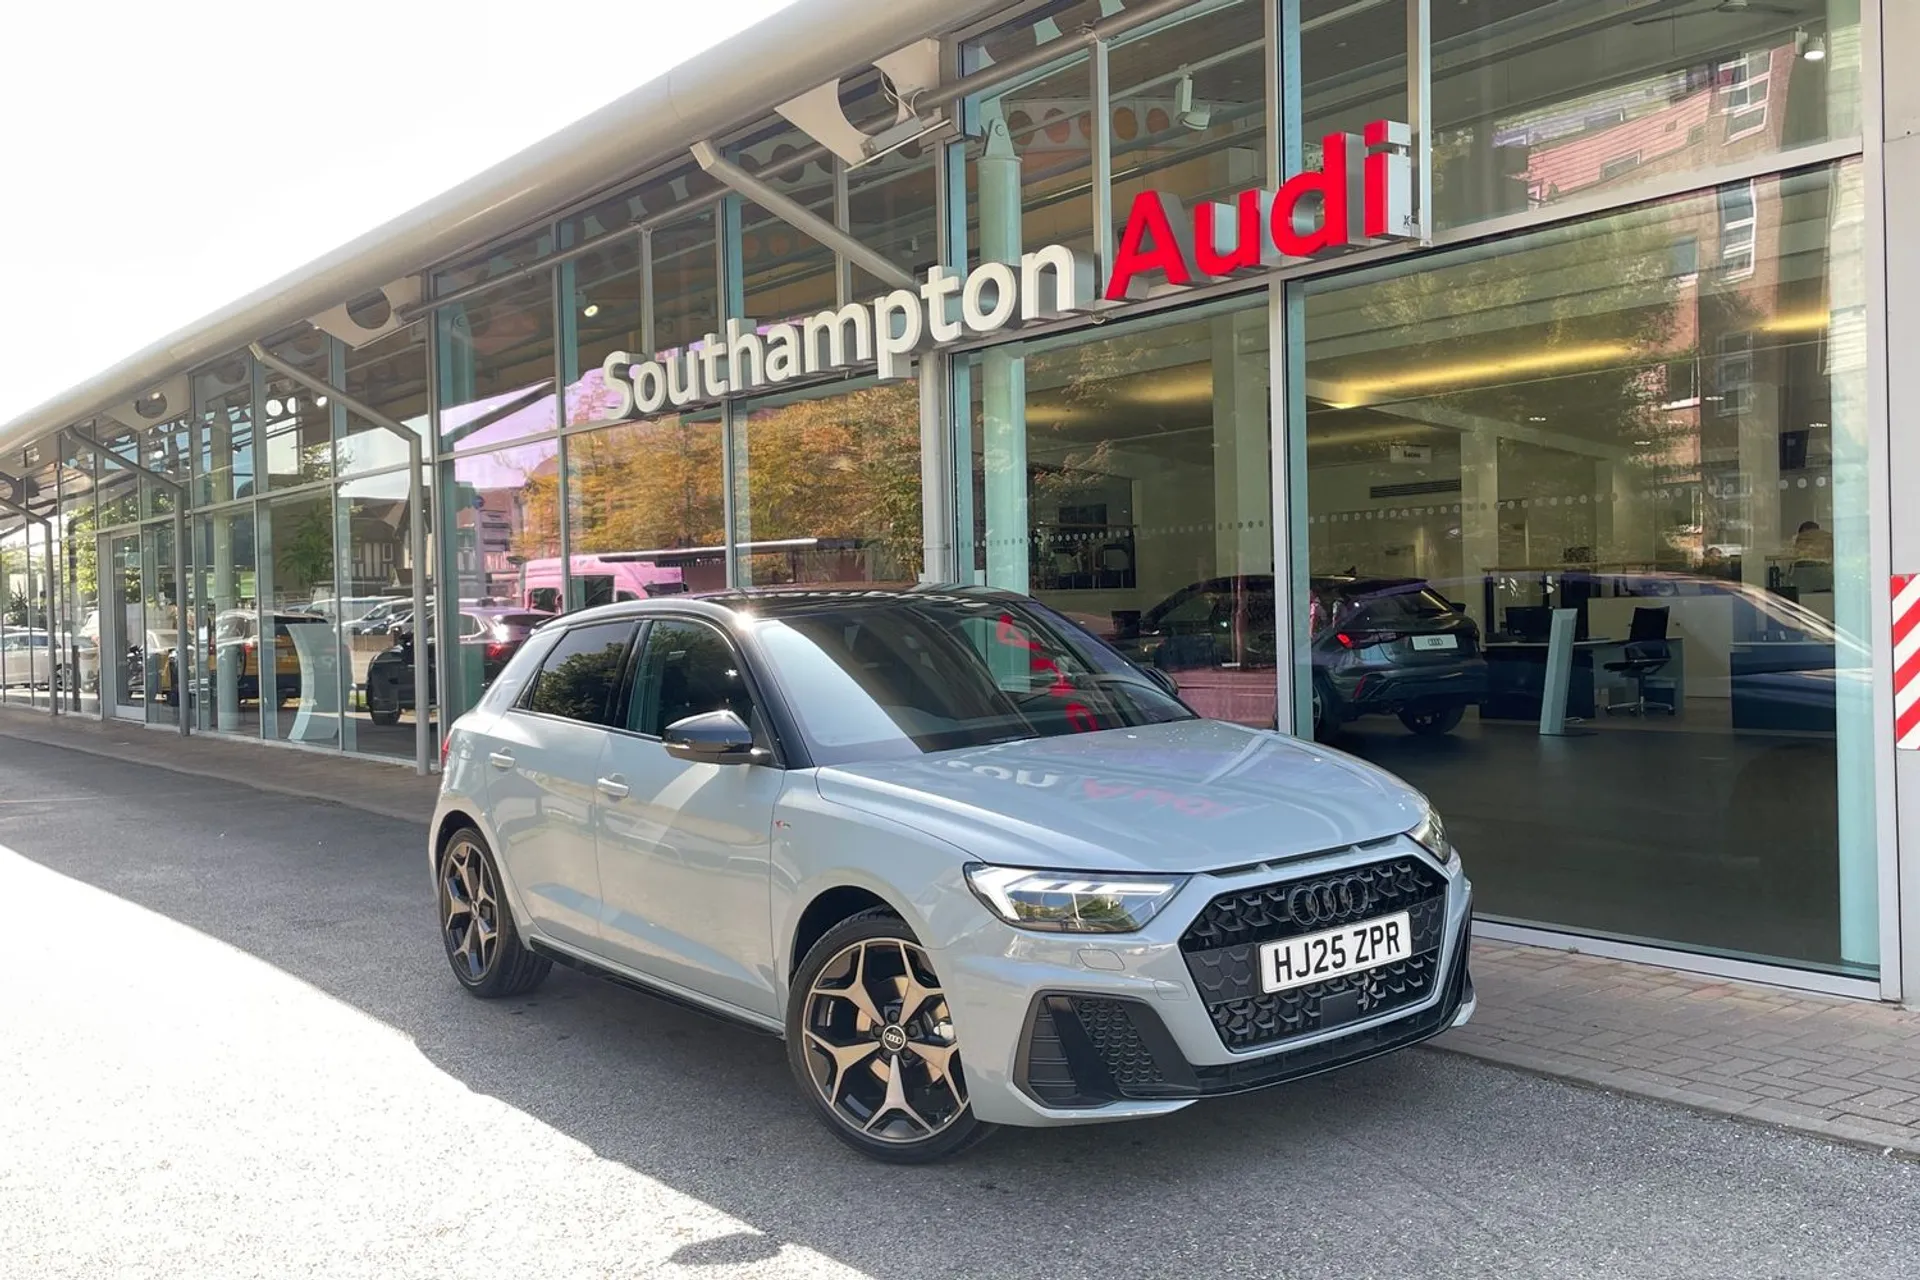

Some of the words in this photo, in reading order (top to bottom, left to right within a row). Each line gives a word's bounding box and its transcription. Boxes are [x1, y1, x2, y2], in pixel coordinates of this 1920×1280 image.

[602, 244, 1076, 420] Southampton
[1105, 119, 1390, 300] Audi
[1273, 934, 1346, 983] HJ25
[1353, 921, 1401, 964] ZPR
